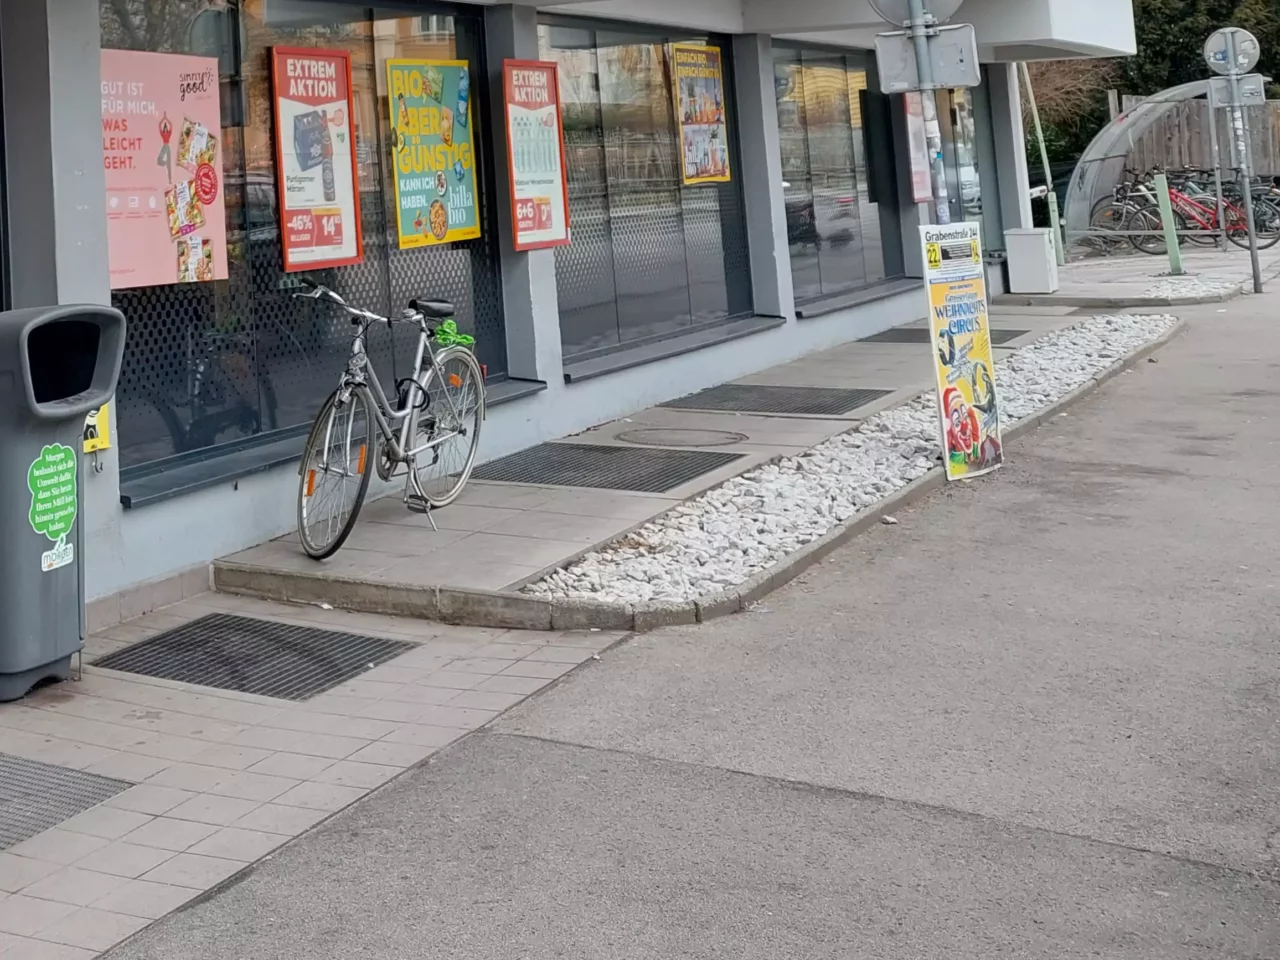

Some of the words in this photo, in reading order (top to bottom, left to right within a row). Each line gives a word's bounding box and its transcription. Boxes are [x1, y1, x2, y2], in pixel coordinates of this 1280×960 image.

[286, 58, 336, 79] EXTREM
[392, 69, 428, 104] BIO,
[512, 70, 548, 87] EXTREM
[101, 81, 123, 95] GUT
[128, 82, 144, 96] IST
[180, 72, 207, 102] good
[289, 78, 337, 98] AKTION
[515, 86, 549, 103] AKTION
[102, 97, 124, 114] FÜR
[128, 101, 159, 117] MICH,
[103, 118, 128, 132] WAS
[398, 107, 441, 136] ABER
[103, 137, 143, 151] LEICHT
[104, 156, 136, 170] GEHT.
[399, 136, 472, 175] GÜNSTIG
[400, 178, 422, 192] KANN
[422, 176, 435, 189] ICH
[401, 194, 428, 210] HABEN.
[449, 185, 474, 209] billa
[448, 201, 467, 225] bio
[925, 229, 968, 242] Grabenstraße
[949, 318, 981, 336] CIRCUS
[45, 452, 65, 462] Morgen
[33, 465, 57, 477] bedankt
[57, 462, 67, 471] sich
[37, 476, 59, 488] Umwelt
[37, 489, 51, 499] dass
[51, 487, 60, 496] Sie
[36, 500, 52, 511] Ihren
[35, 511, 54, 523] hinein
